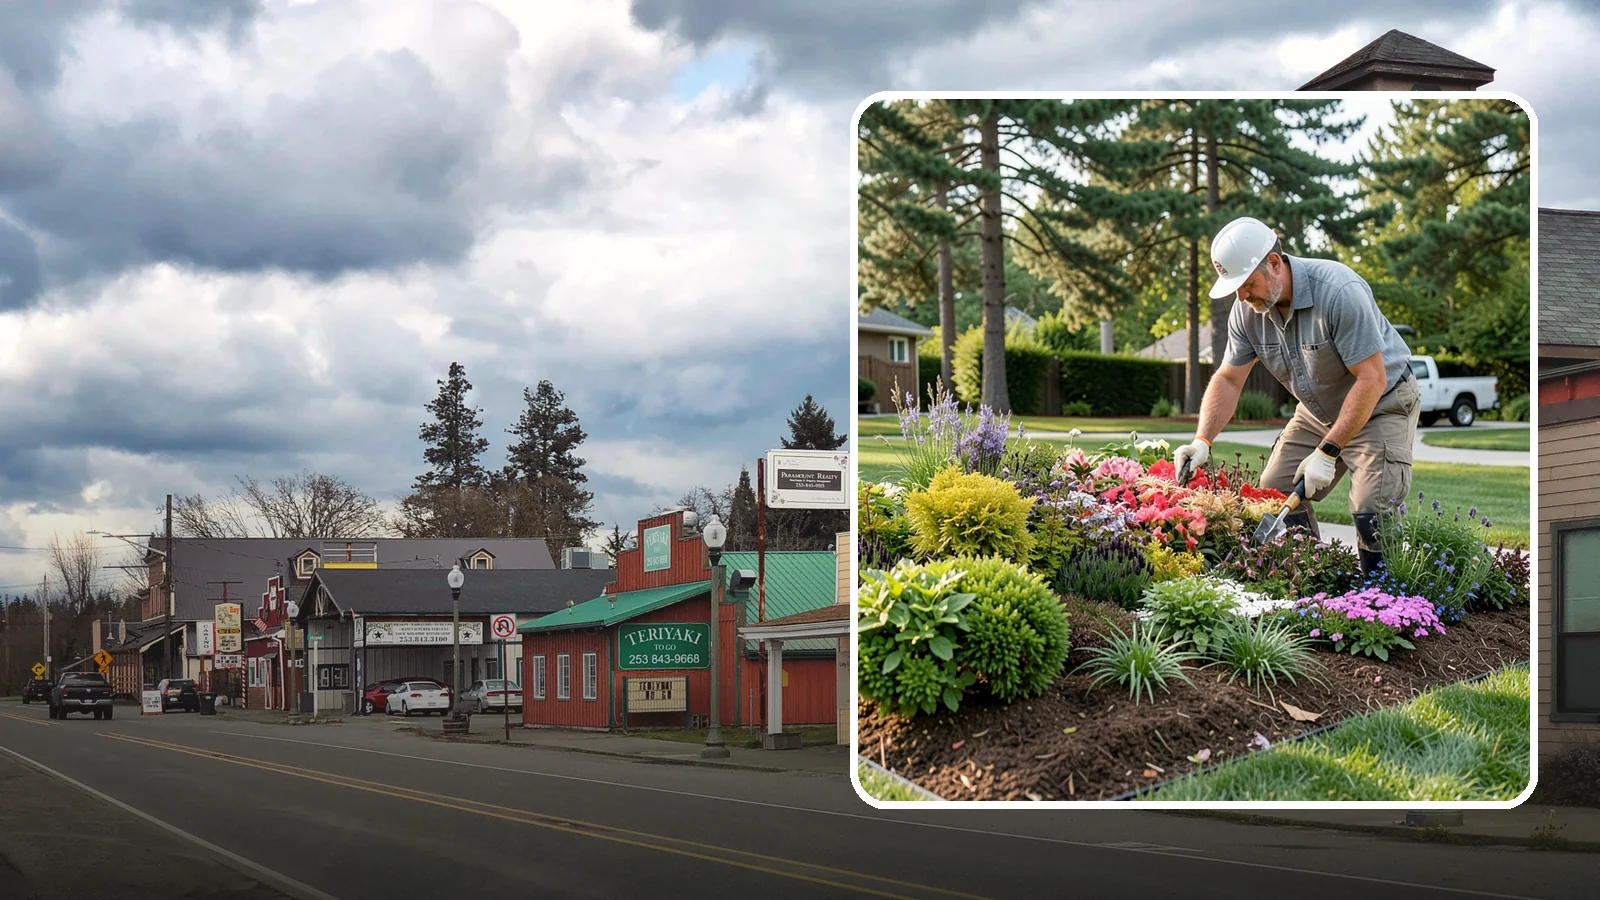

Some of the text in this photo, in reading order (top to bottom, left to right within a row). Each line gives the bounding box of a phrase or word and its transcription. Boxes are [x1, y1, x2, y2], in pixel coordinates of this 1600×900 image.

[781, 471, 839, 480] PARAMOUNT REALTY
[624, 628, 702, 646] TERIYAKI
[629, 654, 700, 664] 253 843-9668
[639, 682, 672, 690] TERIYAKI
